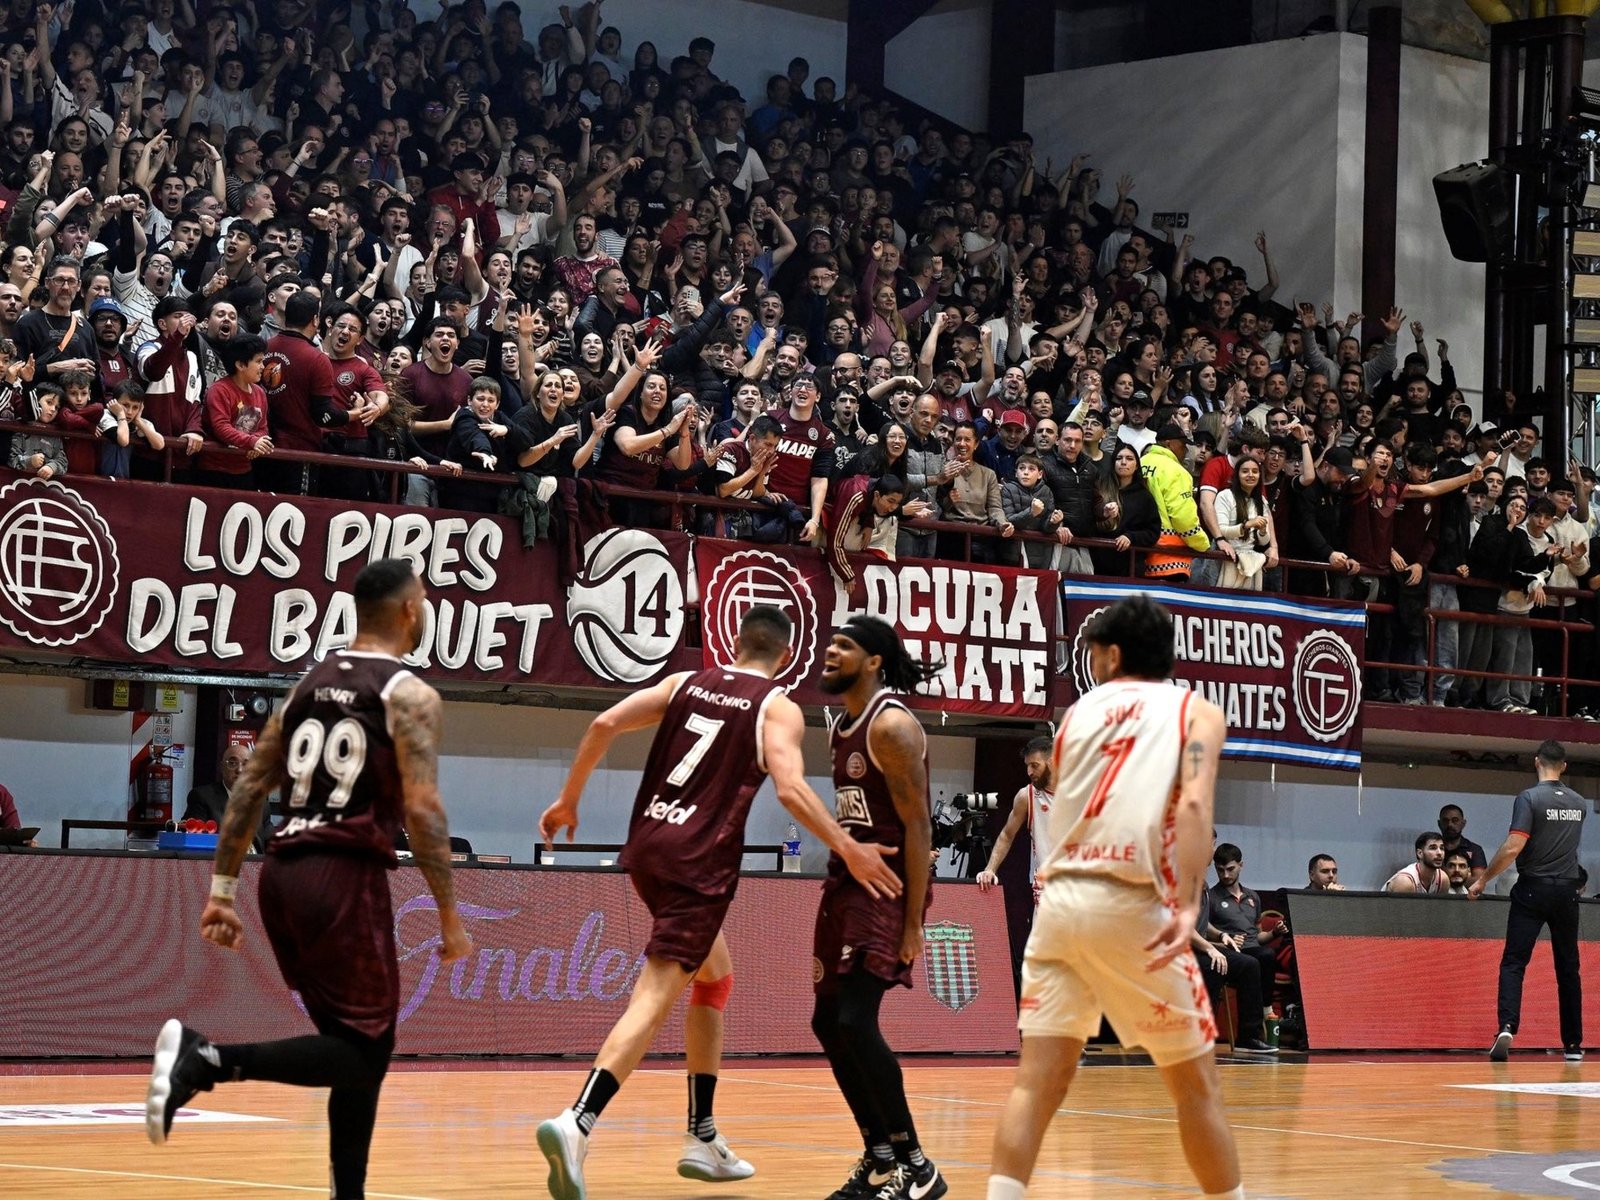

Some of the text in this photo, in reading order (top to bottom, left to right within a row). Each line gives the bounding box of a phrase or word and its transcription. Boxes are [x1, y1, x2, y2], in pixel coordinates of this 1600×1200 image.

[108, 359, 121, 370] 10
[184, 496, 503, 591] LOS PIBES
[126, 577, 553, 674] DEL BAQUET
[620, 570, 671, 638] 14
[831, 564, 1047, 643] LOCURA
[900, 638, 1048, 706] ANATE
[1169, 613, 1285, 669] ACHEROS
[685, 684, 752, 711] FRANCHINO
[1166, 678, 1286, 731] NATES
[286, 717, 367, 807] 99
[666, 712, 726, 788] 7
[1084, 735, 1137, 820] 7
[1546, 808, 1582, 822] SAN ISIDRO
[293, 893, 650, 1022] Finale
